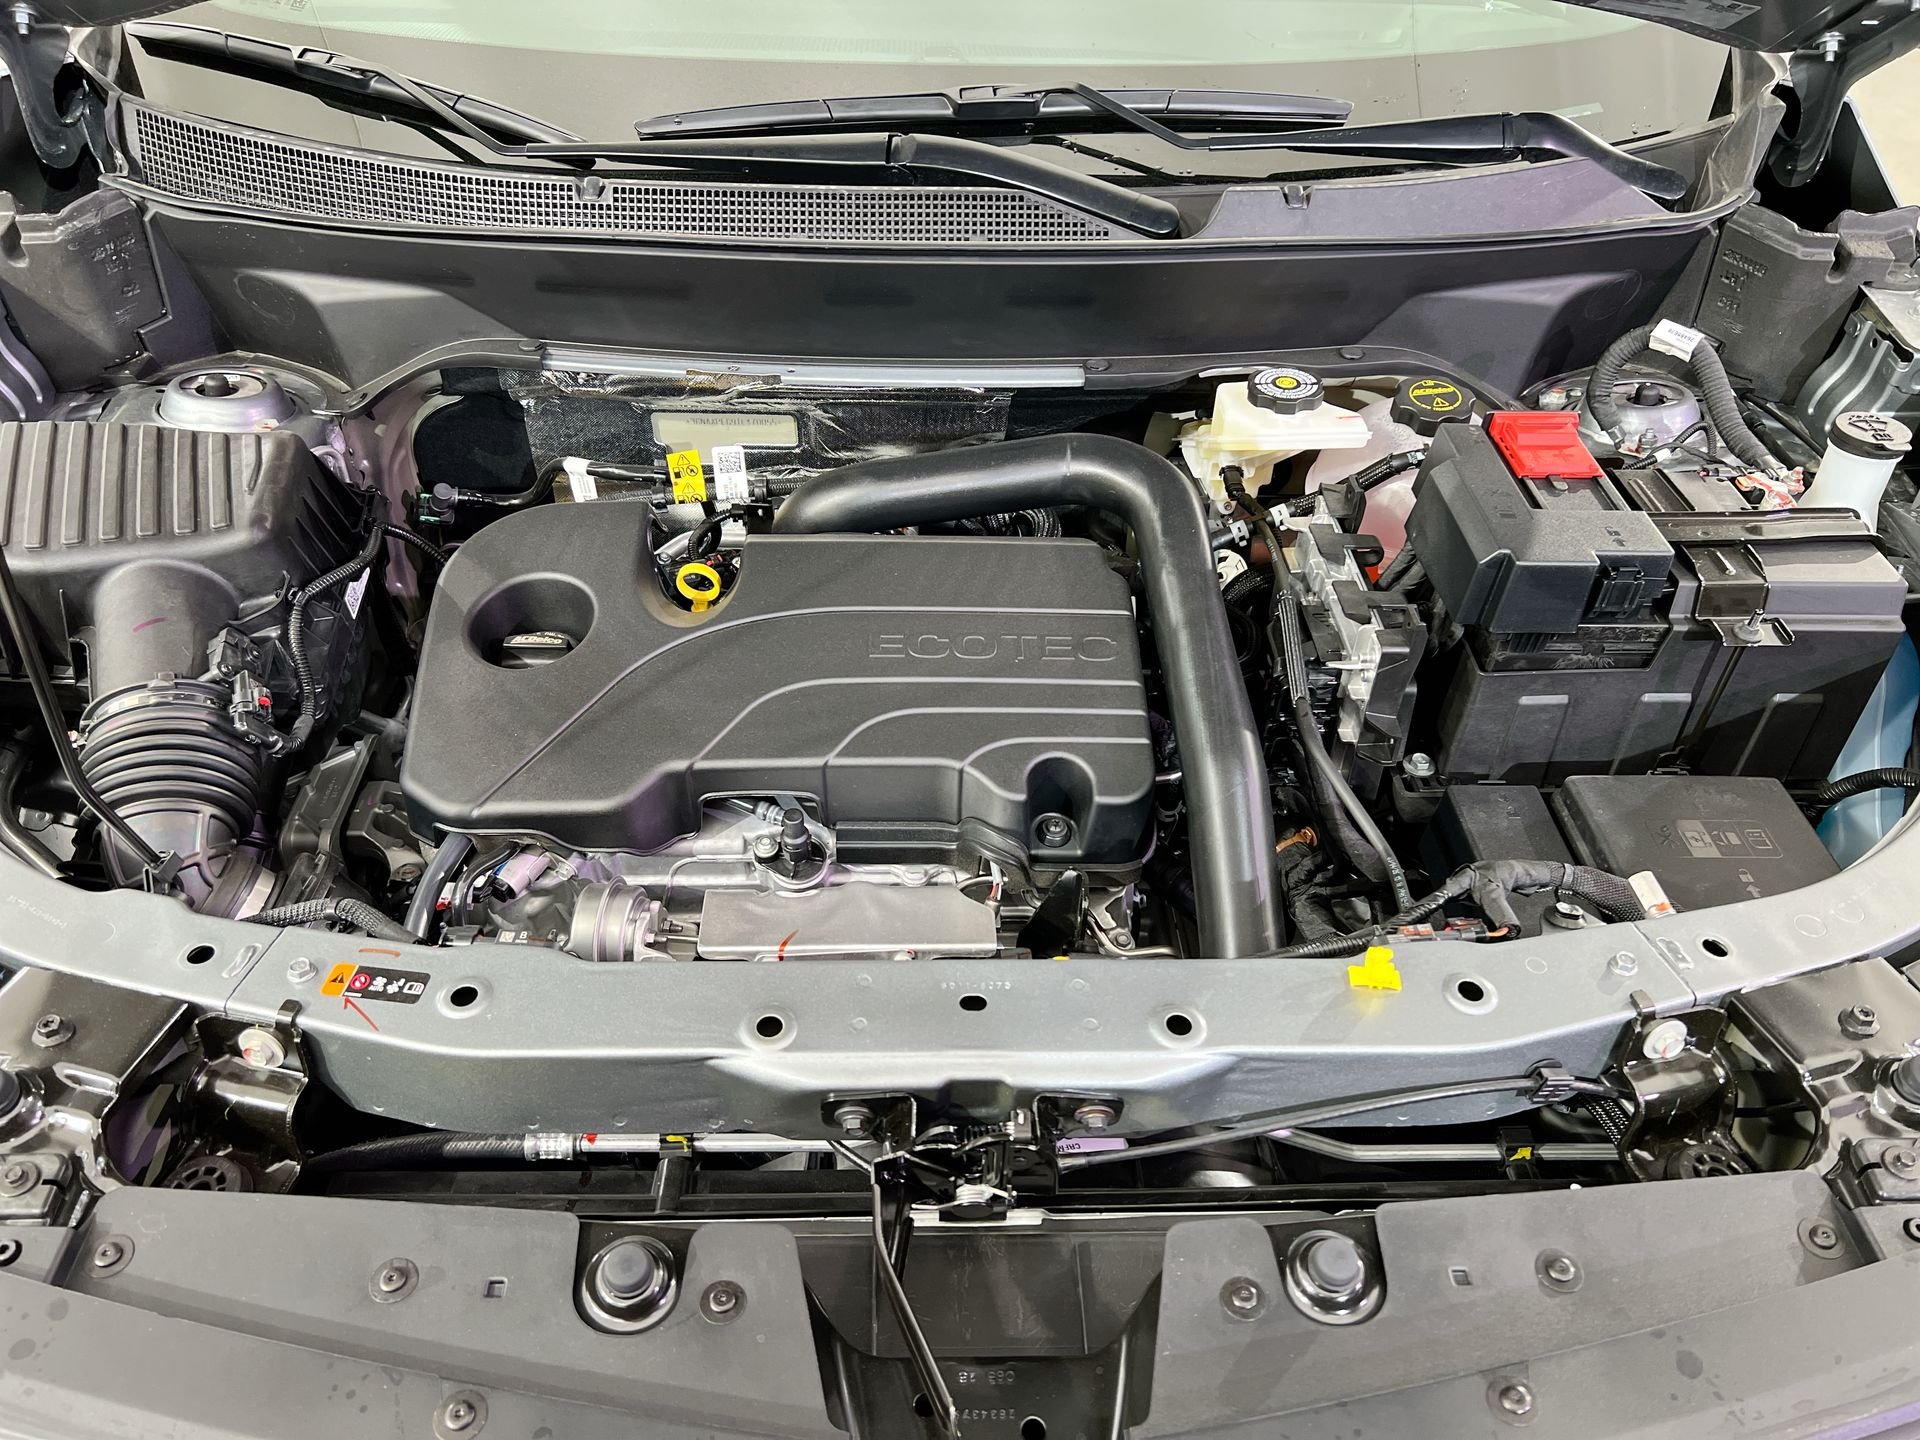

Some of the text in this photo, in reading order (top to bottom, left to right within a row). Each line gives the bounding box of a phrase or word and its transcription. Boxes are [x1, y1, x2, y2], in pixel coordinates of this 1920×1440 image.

[510, 636, 563, 644] ACDelco
[867, 634, 1118, 662] ECOTEC
[367, 984, 384, 992] AUTO
